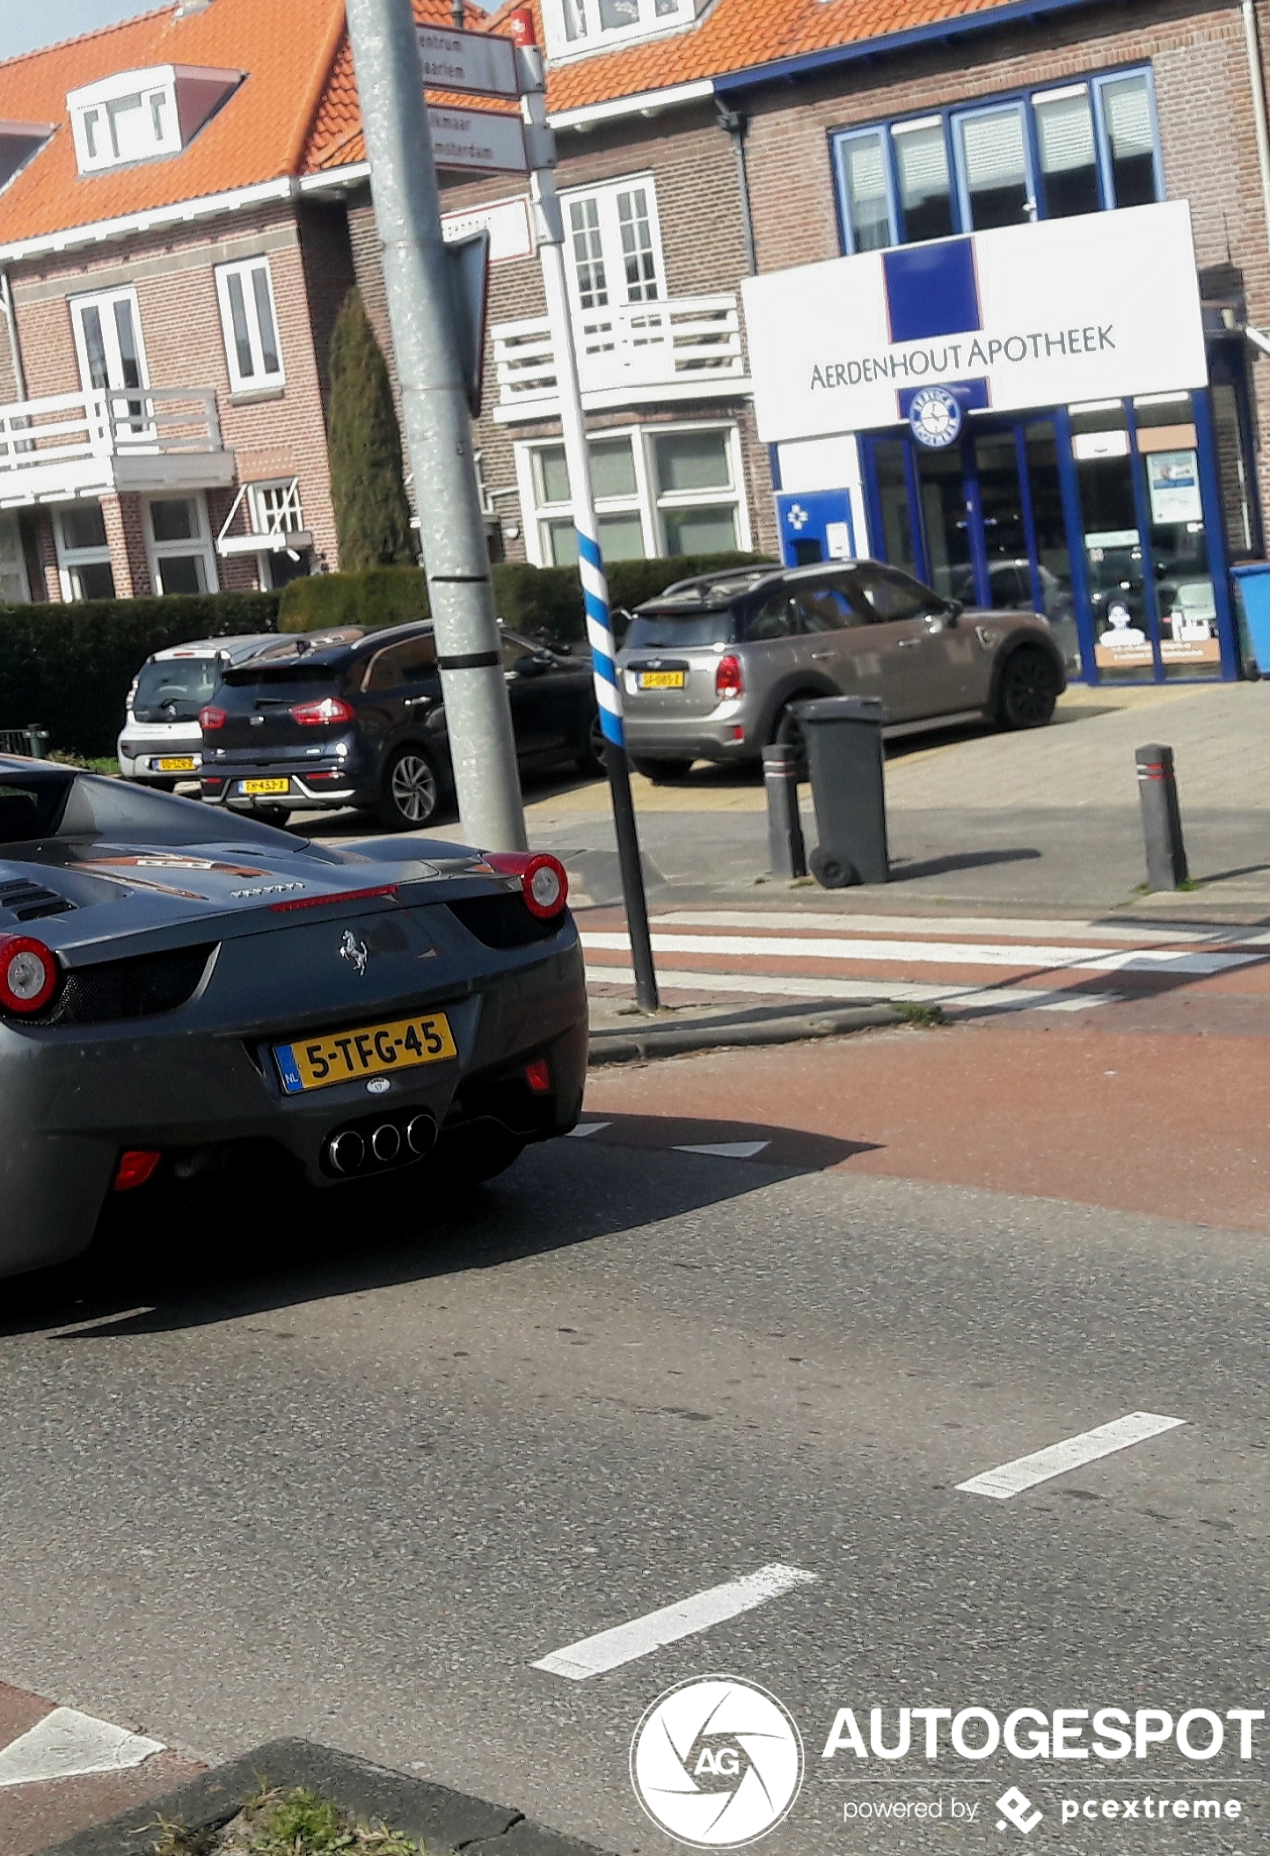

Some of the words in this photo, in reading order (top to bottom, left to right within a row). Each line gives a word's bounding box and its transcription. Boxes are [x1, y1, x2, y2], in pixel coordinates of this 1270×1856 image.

[418, 35, 462, 51] entrum
[423, 61, 465, 79] aarlem
[433, 142, 493, 159] msterdam
[810, 344, 963, 390] AERDENHOUT
[967, 324, 1116, 368] APOTHEEK
[284, 1072, 299, 1084] NL
[306, 1021, 443, 1078] 5-TFG-45
